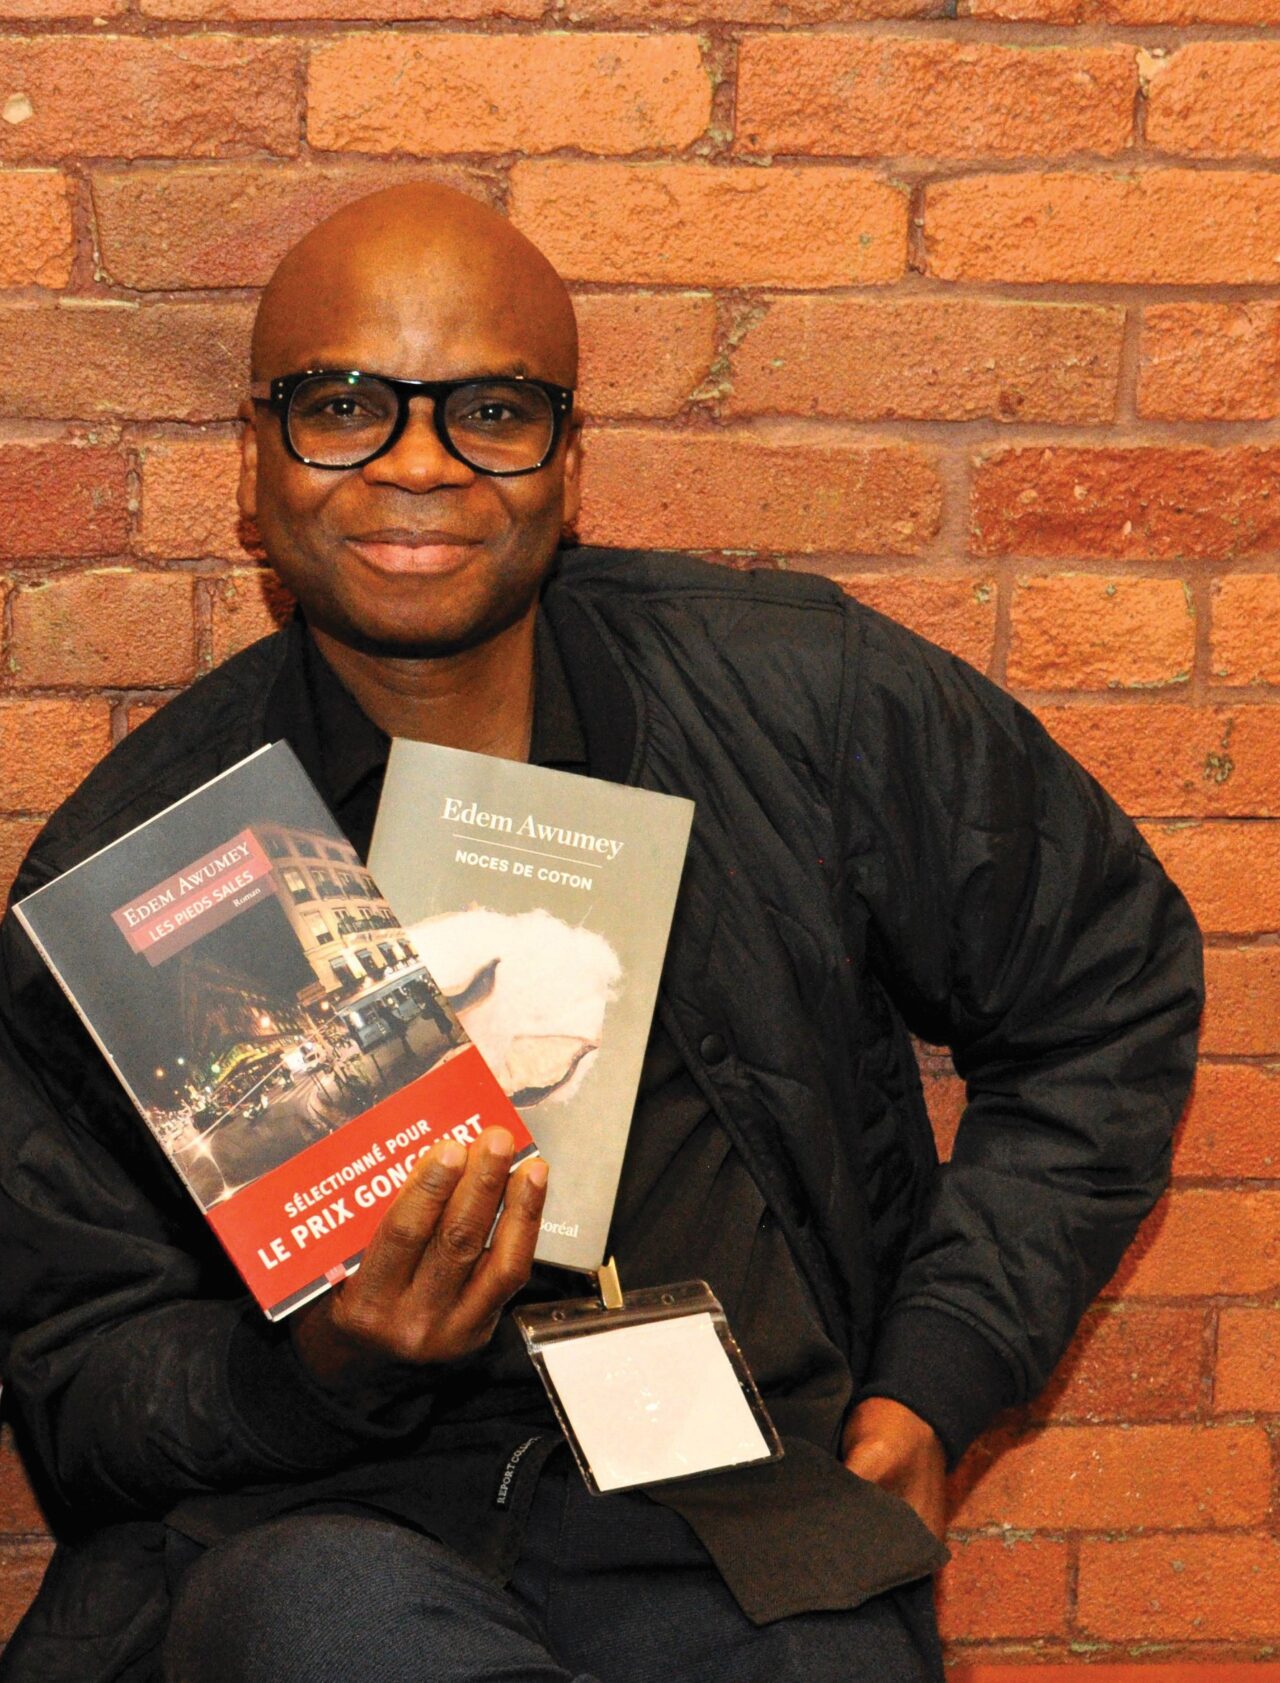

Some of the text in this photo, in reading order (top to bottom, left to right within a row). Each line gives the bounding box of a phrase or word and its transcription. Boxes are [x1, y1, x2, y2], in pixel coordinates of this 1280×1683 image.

[440, 797, 625, 860] Edem Awumey
[123, 842, 251, 927] EDEM AWUMEY
[233, 886, 261, 908] Roman
[455, 850, 593, 891] NOCES DE COTON
[148, 870, 254, 942] LES PIEDS SALES
[257, 1114, 485, 1270] LE PRIX GONCRT
[284, 1119, 432, 1219] SÉLECTIONNÉ POUR
[496, 1463, 515, 1503] REPORT
